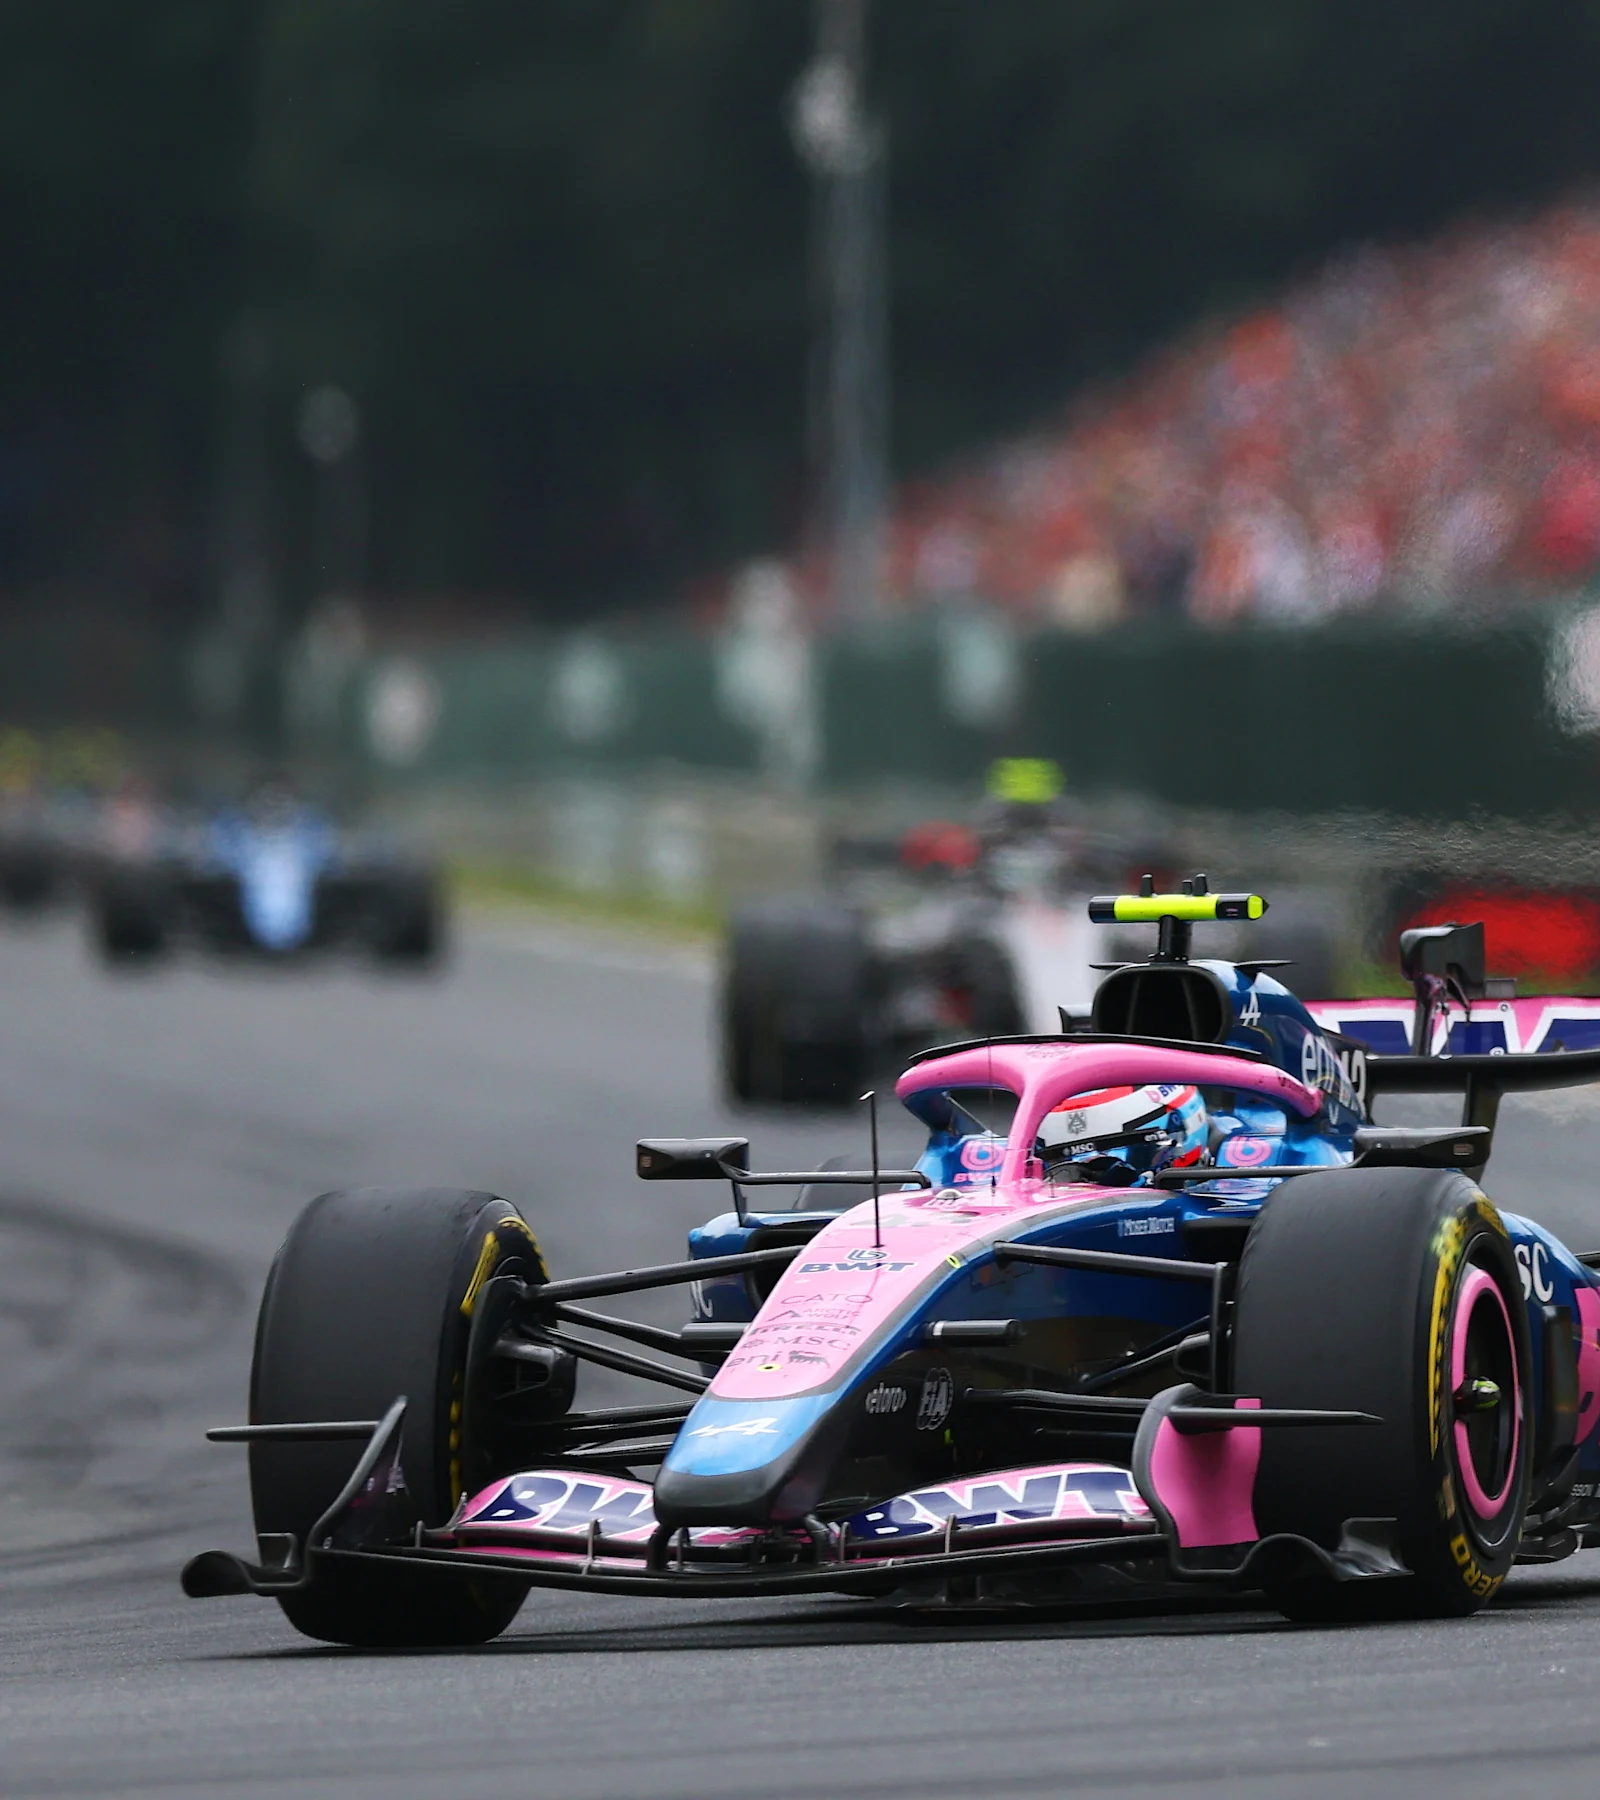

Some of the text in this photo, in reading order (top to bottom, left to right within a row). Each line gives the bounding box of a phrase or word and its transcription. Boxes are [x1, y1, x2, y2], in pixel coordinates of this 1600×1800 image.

[1070, 1143, 1094, 1155] MSC
[798, 1262, 915, 1274] BWT
[1512, 1242, 1553, 1302] SC
[780, 1293, 873, 1305] CATO
[773, 1336, 851, 1350] MSC
[726, 1351, 783, 1368] eni
[919, 1381, 948, 1416] FIA
[460, 1473, 660, 1542] BW
[849, 1468, 1140, 1537] BWT
